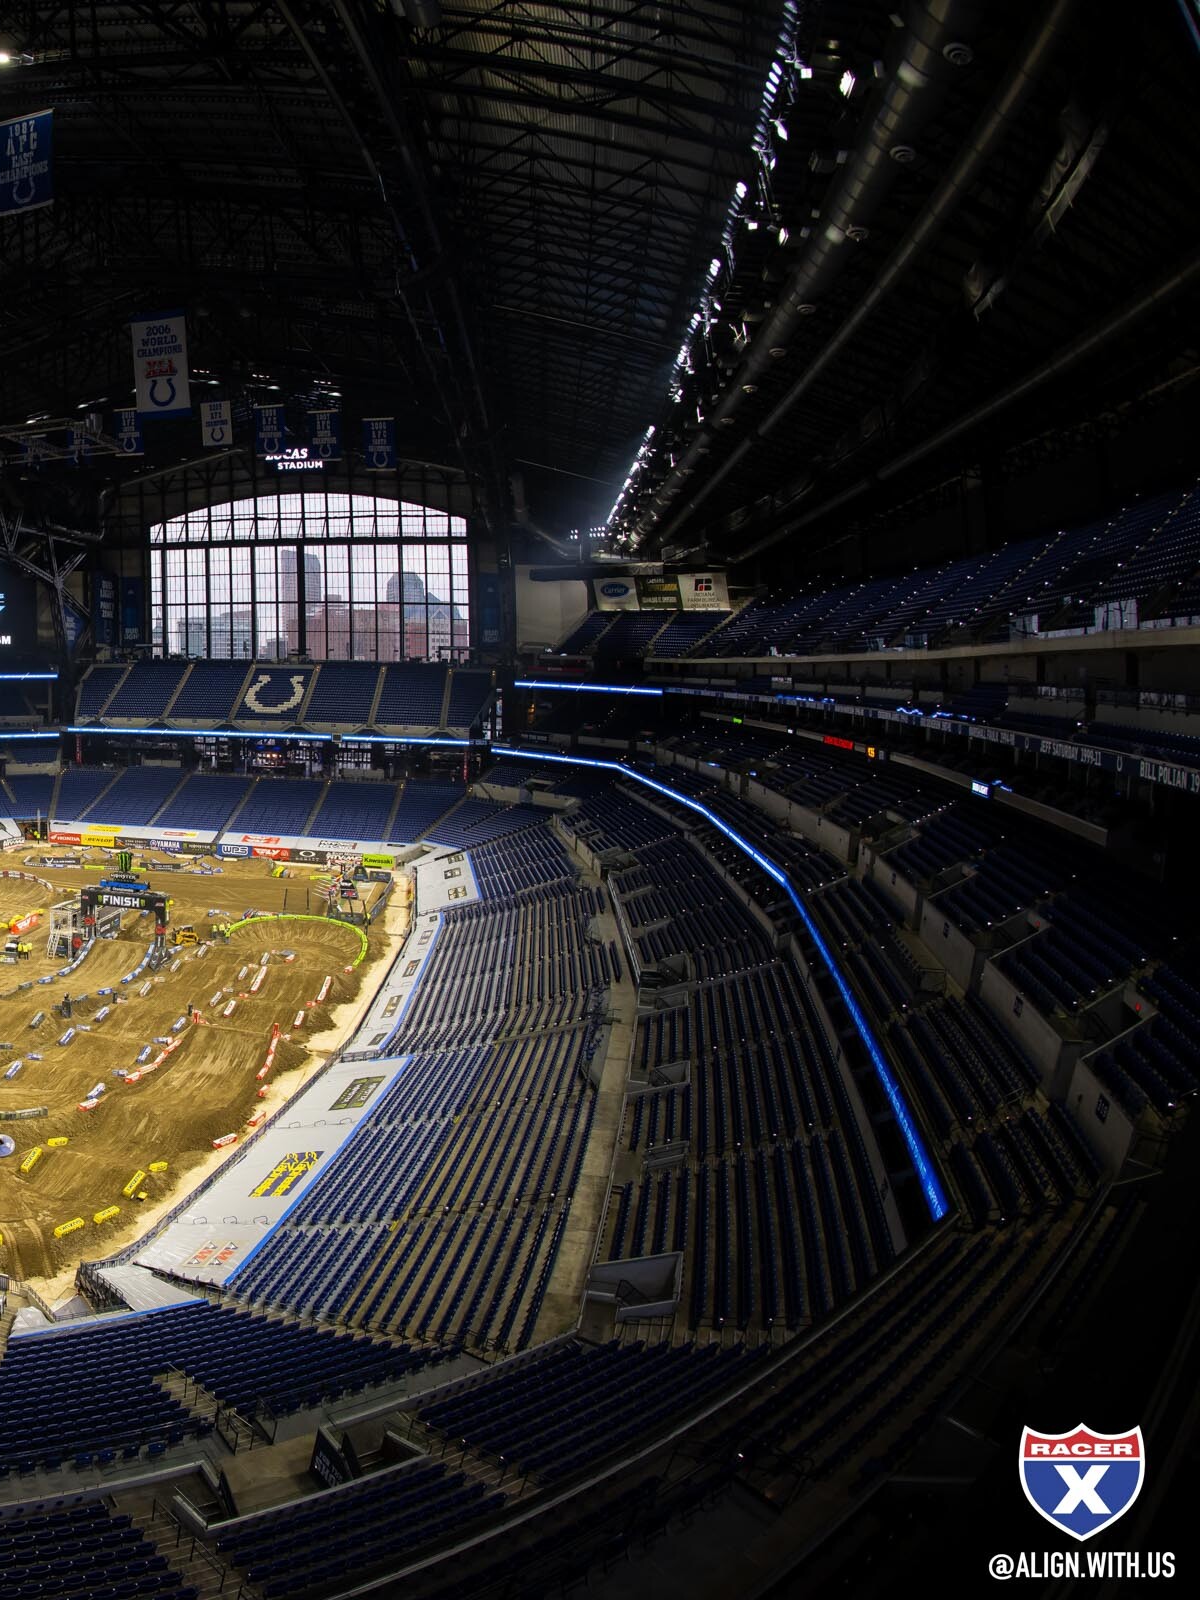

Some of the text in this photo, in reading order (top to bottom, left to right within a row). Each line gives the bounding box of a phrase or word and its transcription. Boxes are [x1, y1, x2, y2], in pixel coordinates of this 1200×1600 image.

[9, 120, 35, 137] 1987
[6, 132, 37, 155] AFC
[11, 152, 34, 169] EAST
[0, 160, 48, 184] CHAMPIONS
[146, 324, 171, 336] 2006
[141, 335, 178, 347] WORLD
[137, 344, 182, 358] CHAMPIONS
[277, 461, 323, 470] STADIUM
[603, 585, 627, 594] Carrier
[1040, 739, 1052, 753] JEFF
[1052, 743, 1079, 760] SATURDAY
[1139, 760, 1157, 780] BILL
[1158, 766, 1187, 790] POLIAN
[57, 833, 81, 842] HONDA
[157, 840, 181, 849] YAMAHA
[222, 845, 249, 855] WPS
[253, 847, 281, 857] FLY
[364, 857, 393, 865] Kawasaki
[102, 894, 140, 908] FINISH
[23, 1147, 40, 1169] SUZUKI
